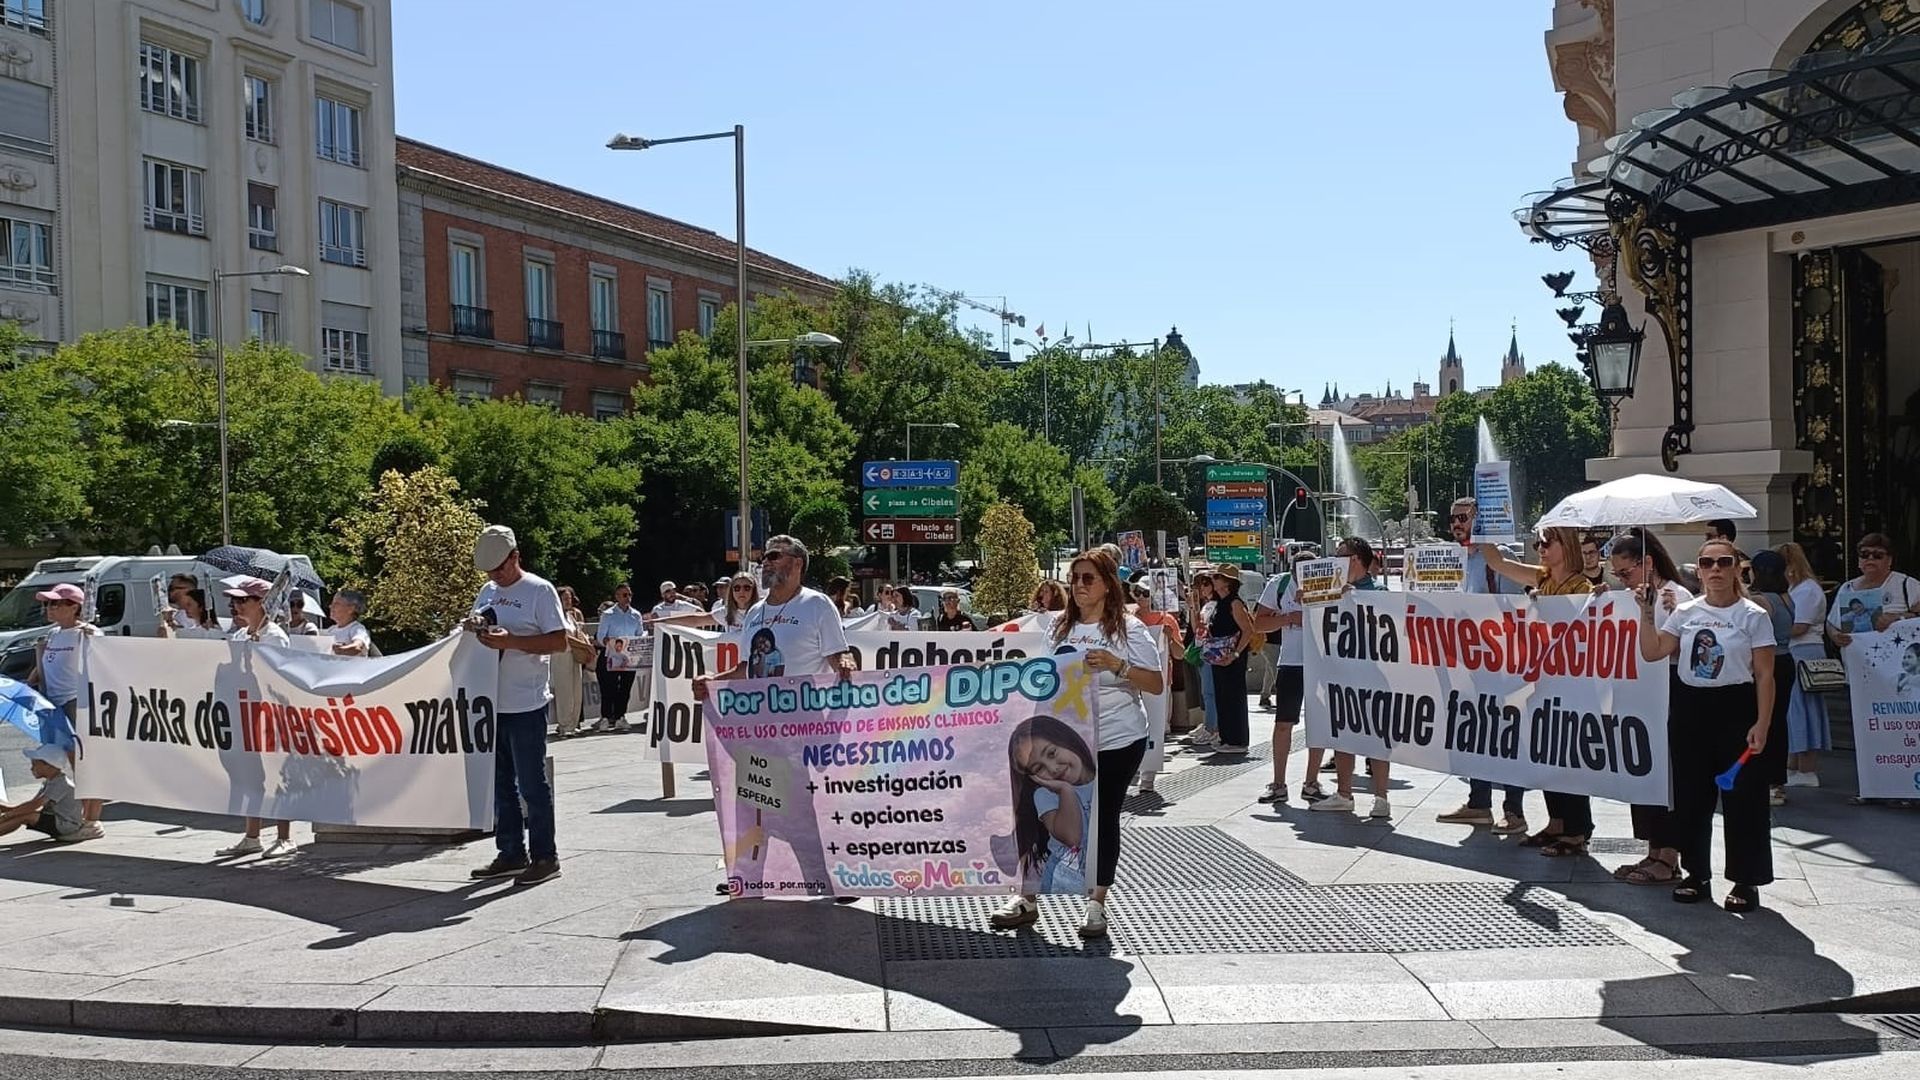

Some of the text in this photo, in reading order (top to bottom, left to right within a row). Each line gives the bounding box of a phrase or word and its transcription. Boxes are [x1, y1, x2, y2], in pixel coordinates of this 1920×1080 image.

[921, 497, 954, 506] Cibeles
[911, 523, 954, 531] Palacio de
[924, 532, 954, 540] Cibeles
[1323, 601, 1638, 683] Falta investigación
[661, 632, 705, 680] Un
[876, 638, 1027, 671] debí
[718, 688, 764, 715] Por
[768, 683, 797, 713] la
[801, 680, 880, 711] lucha
[883, 673, 931, 705] del
[88, 682, 117, 738] La
[195, 692, 232, 751] de
[239, 690, 403, 757] inversión
[404, 688, 495, 755] mata
[716, 725, 734, 739] POR
[738, 724, 750, 738] EL
[754, 723, 777, 738] USO
[781, 720, 852, 738] COMPASIVO
[856, 718, 874, 732] DE
[878, 714, 930, 731] ENSAYOS
[1328, 683, 1654, 777] porque falta dinero
[1869, 717, 1879, 731] El
[1884, 720, 1902, 730] uso
[803, 736, 955, 768] NECESITAMOS
[1904, 734, 1917, 747] de
[750, 755, 768, 769] NO
[747, 772, 772, 788] MAS
[824, 770, 963, 796] investigación
[737, 786, 781, 808] ESPERAS
[851, 805, 944, 829] opciones
[846, 839, 967, 860] esperanzas
[834, 862, 894, 888] todos
[899, 874, 919, 886] por
